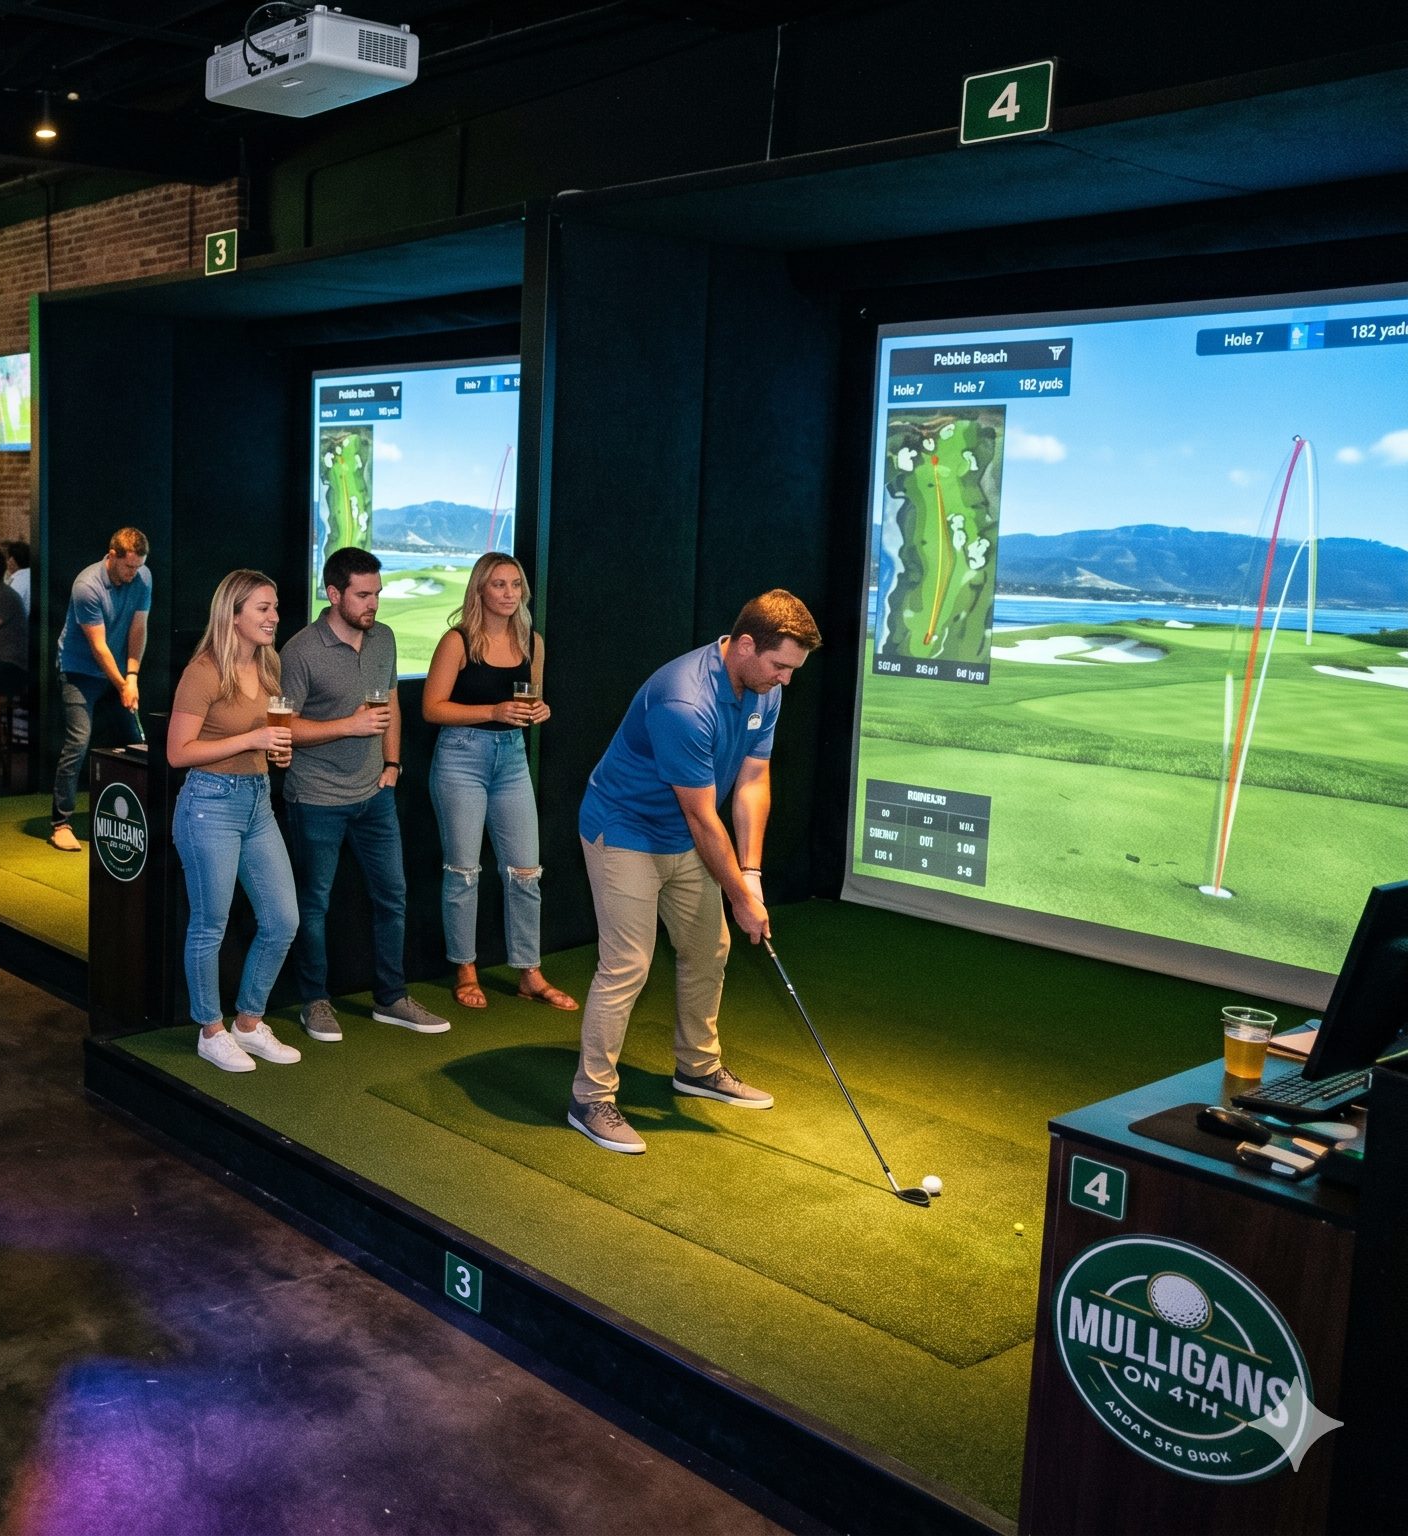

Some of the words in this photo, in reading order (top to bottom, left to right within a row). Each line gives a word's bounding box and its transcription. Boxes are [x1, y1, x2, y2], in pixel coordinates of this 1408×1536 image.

[988, 82, 1020, 122] 4
[215, 238, 227, 266] 3
[1224, 333, 1252, 347] Hole
[1255, 331, 1263, 344] 7
[1351, 324, 1376, 338] 182
[933, 351, 971, 366] Pebble
[973, 349, 1008, 364] Beach
[893, 384, 914, 396] Hole
[916, 383, 923, 395] 7
[953, 381, 976, 393] Hole
[978, 380, 985, 392] 7
[1018, 379, 1037, 390] 182
[1083, 1171, 1111, 1206] 4
[454, 1265, 471, 1298] 3
[1068, 1296, 1292, 1429] MULLIGANS
[1123, 1365, 1160, 1393] ON
[1168, 1386, 1219, 1419] 4TH
